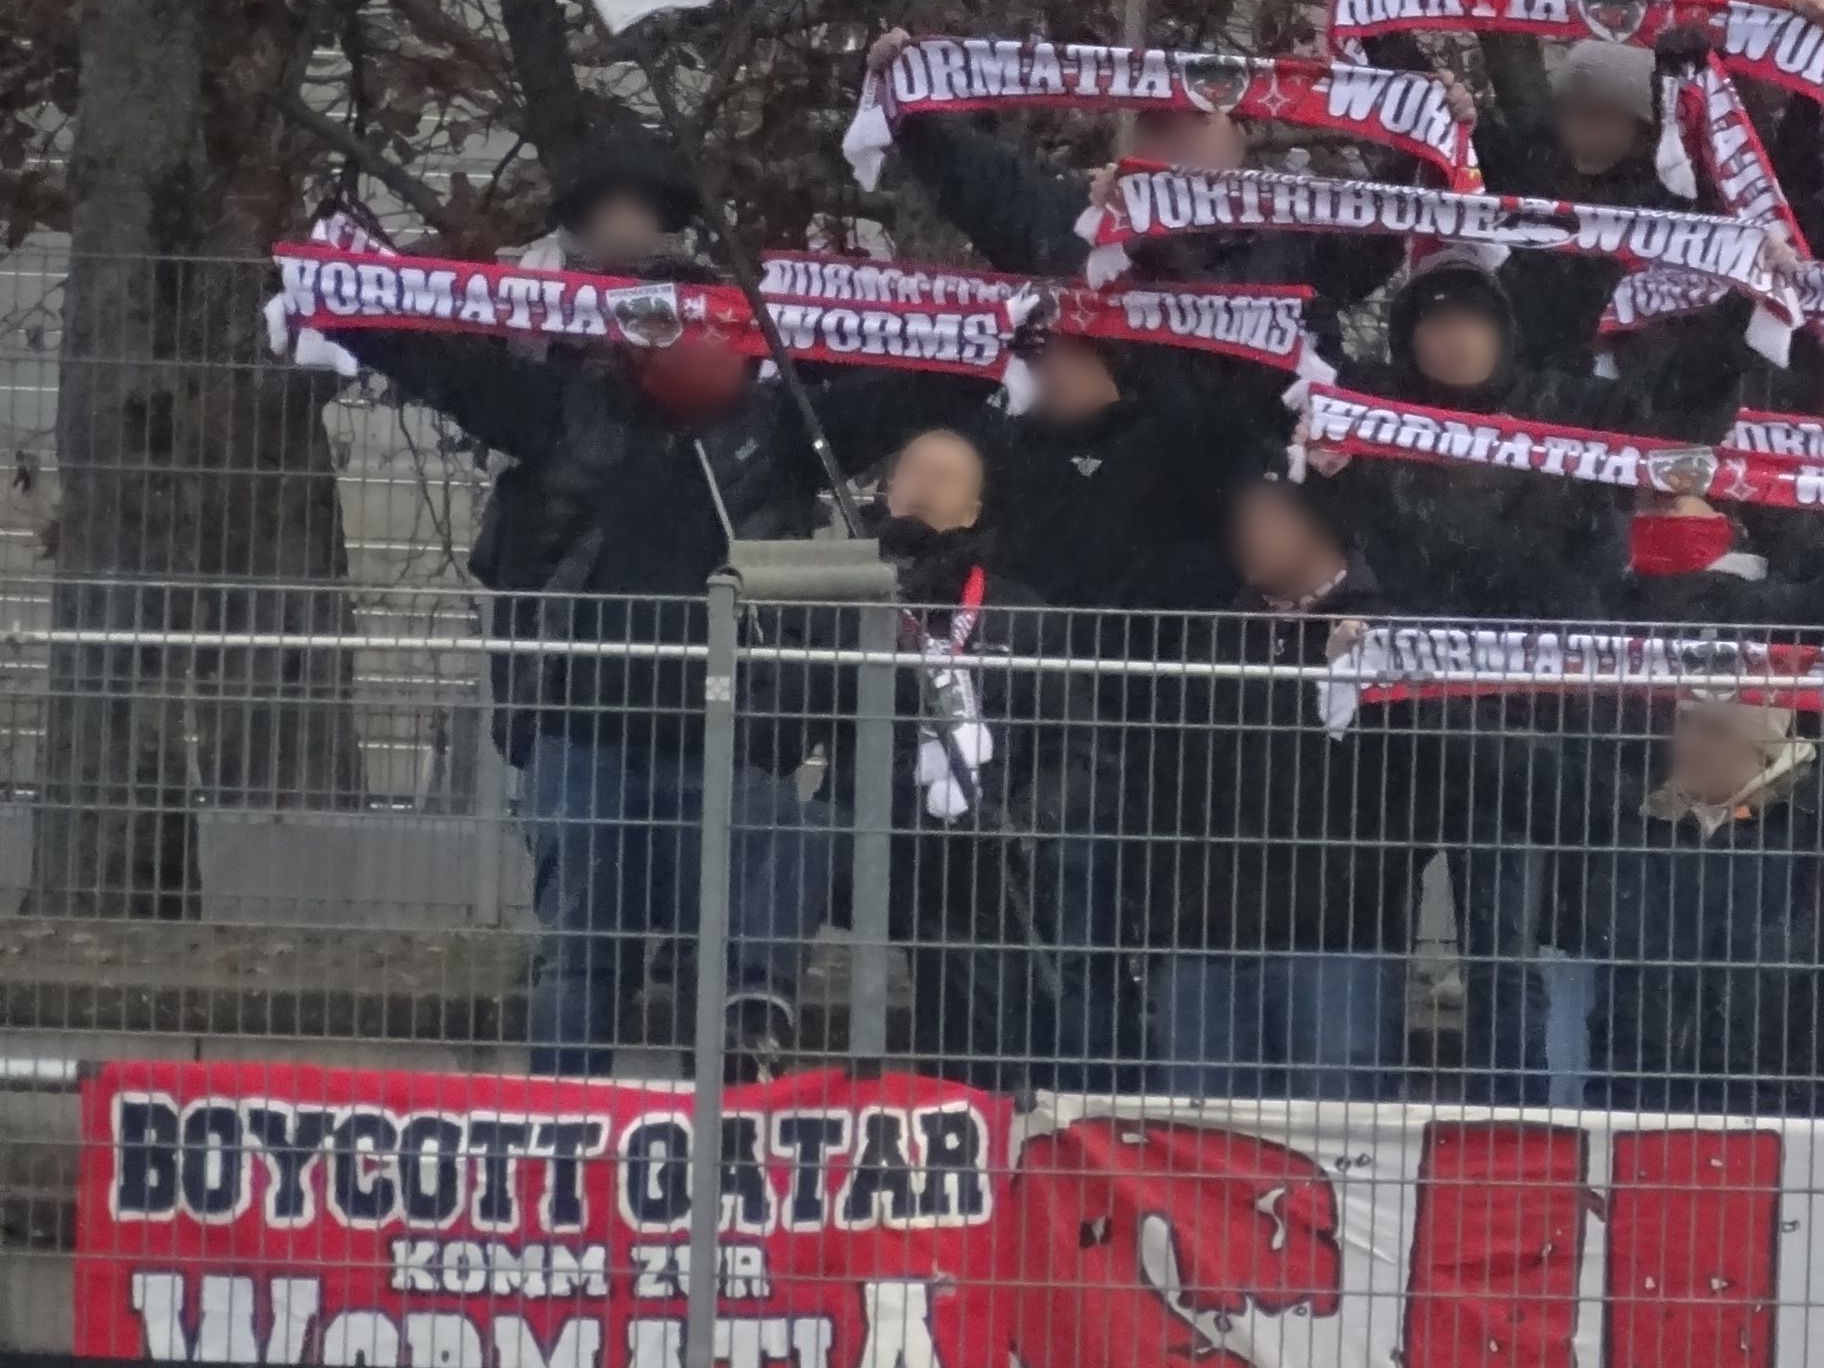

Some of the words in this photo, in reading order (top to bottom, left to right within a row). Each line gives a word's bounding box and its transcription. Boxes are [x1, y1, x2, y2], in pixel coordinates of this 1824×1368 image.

[892, 38, 1172, 104] ORMATIA
[762, 303, 1001, 367] WORMS
[1311, 394, 1640, 486] WORMATIA
[109, 1090, 609, 1230] BOYCOTT
[617, 1098, 996, 1236] QATAR
[389, 1237, 611, 1299] KOMM
